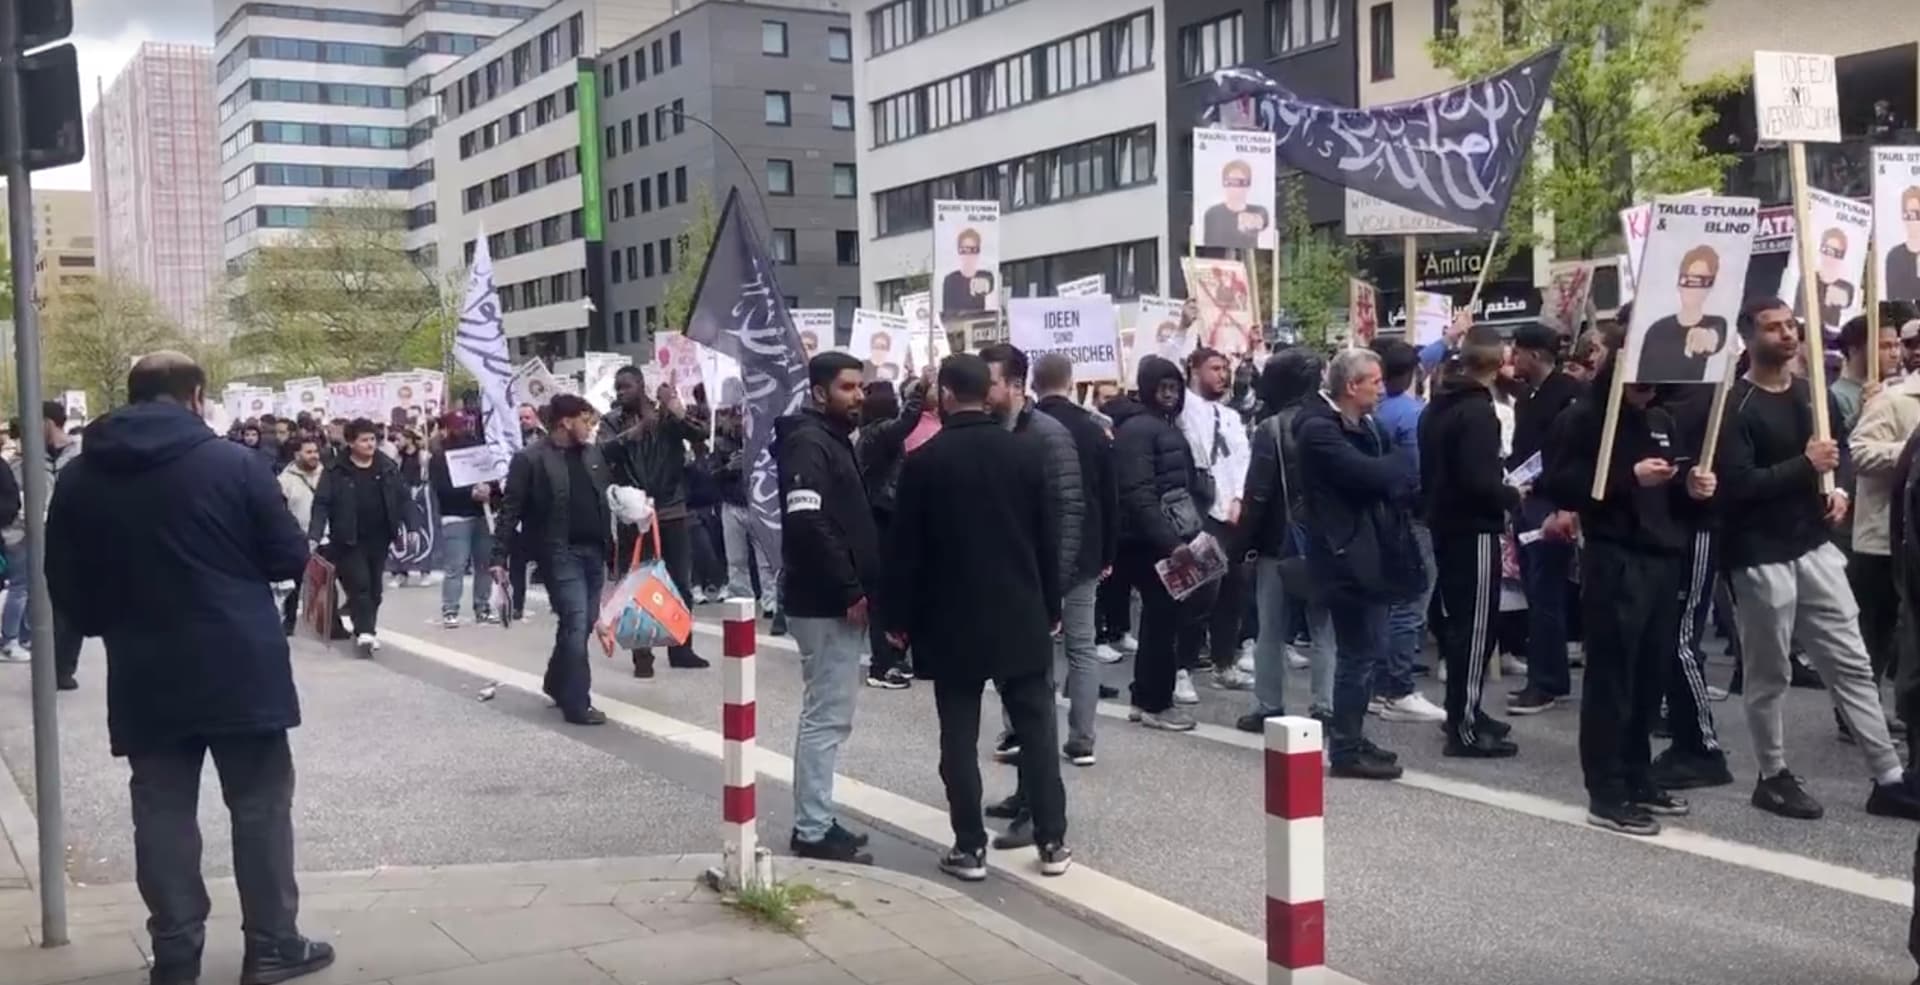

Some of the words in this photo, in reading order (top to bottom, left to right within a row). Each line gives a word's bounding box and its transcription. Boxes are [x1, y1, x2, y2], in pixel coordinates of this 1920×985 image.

[1701, 205, 1756, 217] STUMM
[1656, 217, 1667, 231] &
[1703, 221, 1750, 235] BLIND
[1043, 309, 1081, 329] IDEEN
